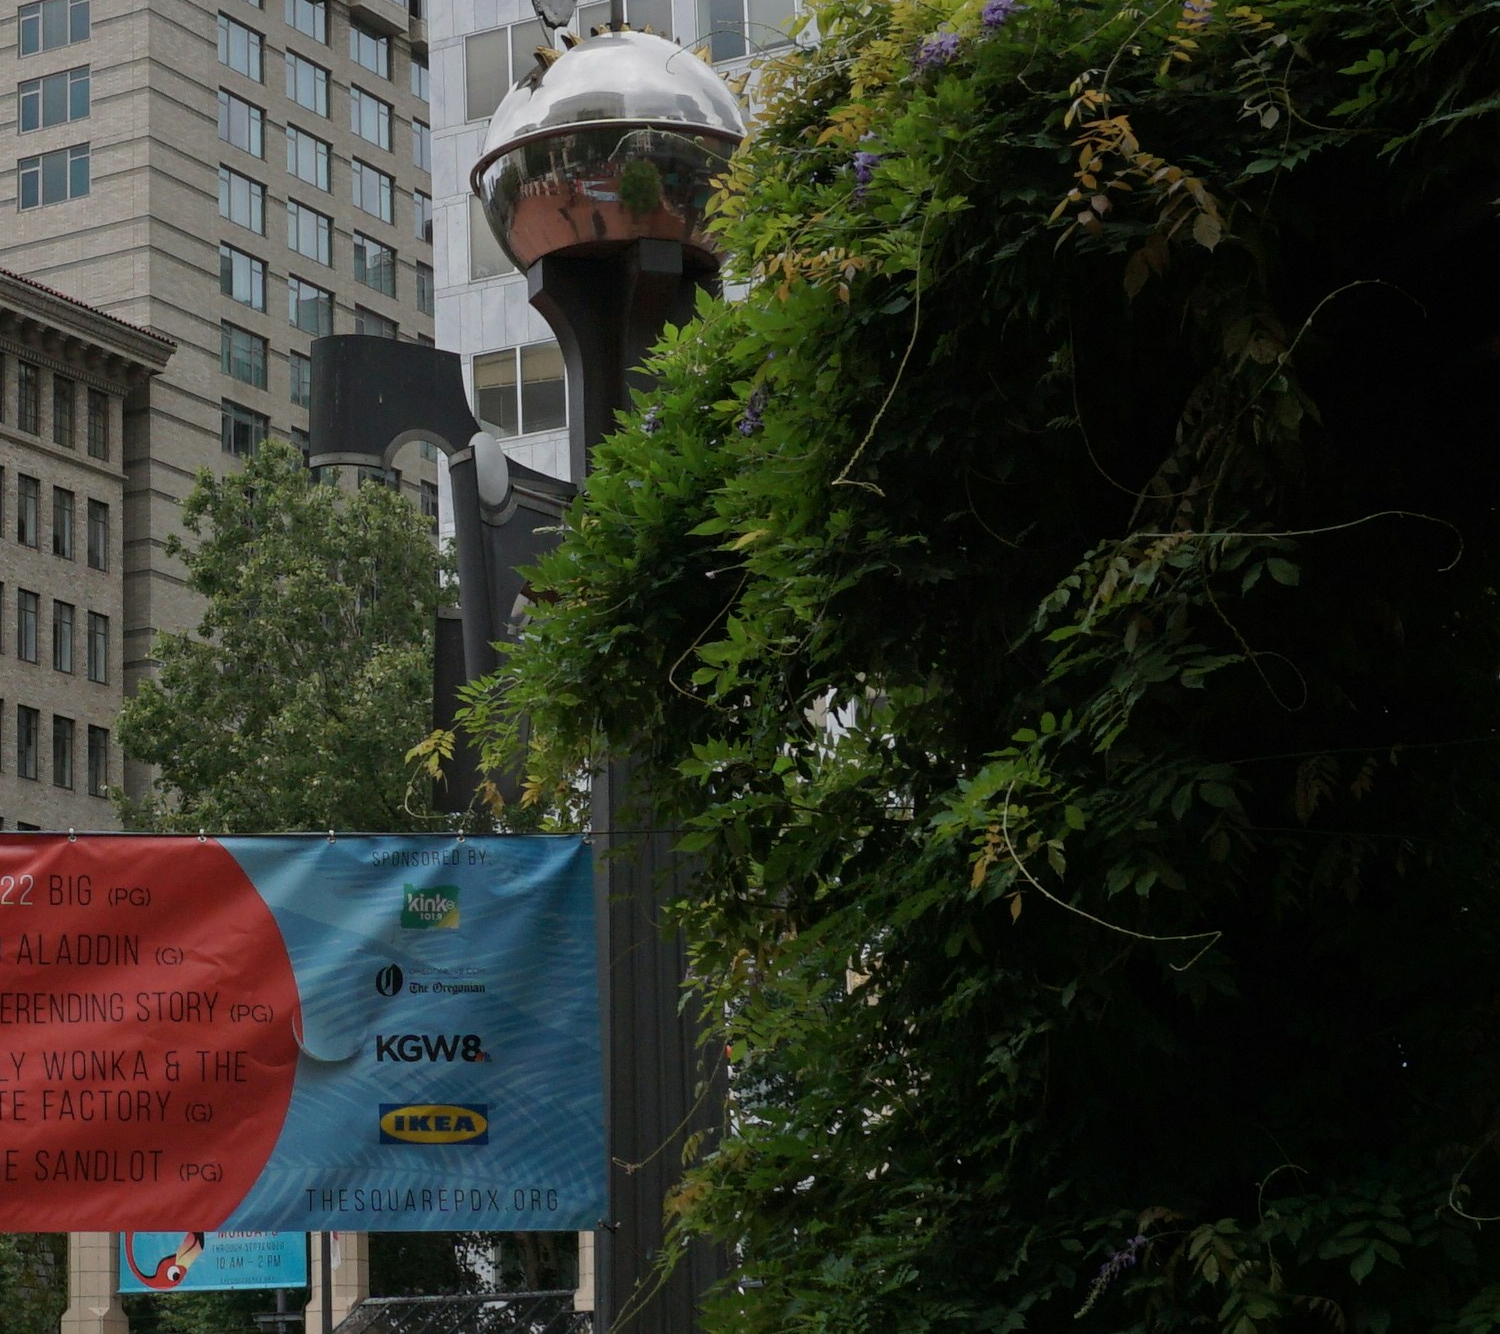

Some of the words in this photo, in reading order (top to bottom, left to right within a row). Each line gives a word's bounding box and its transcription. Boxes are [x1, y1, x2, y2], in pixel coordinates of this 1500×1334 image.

[371, 849, 461, 867] SPONSORED
[0, 873, 35, 906] 22
[48, 874, 92, 906] BIG
[107, 887, 152, 907] (PG)
[16, 933, 140, 966] ALADDIN
[155, 947, 185, 966] (G)
[408, 981, 431, 994] The
[432, 981, 486, 995] Oregonian
[136, 990, 220, 1023] STORY
[229, 1003, 275, 1024] (PG)
[375, 1034, 482, 1063] KGW8
[42, 1050, 150, 1083] WONKA
[165, 1050, 181, 1083] &
[195, 1050, 249, 1083] THE
[42, 1089, 172, 1123] FACTORY
[184, 1102, 214, 1124] (G)
[394, 1114, 478, 1133] IKEA
[34, 1148, 165, 1183] SANDLOT
[179, 1162, 224, 1184] (PG)
[306, 1188, 560, 1213] THESQUAREPDX.ORG
[229, 1256, 244, 1269] AM
[267, 1254, 281, 1268] PM
